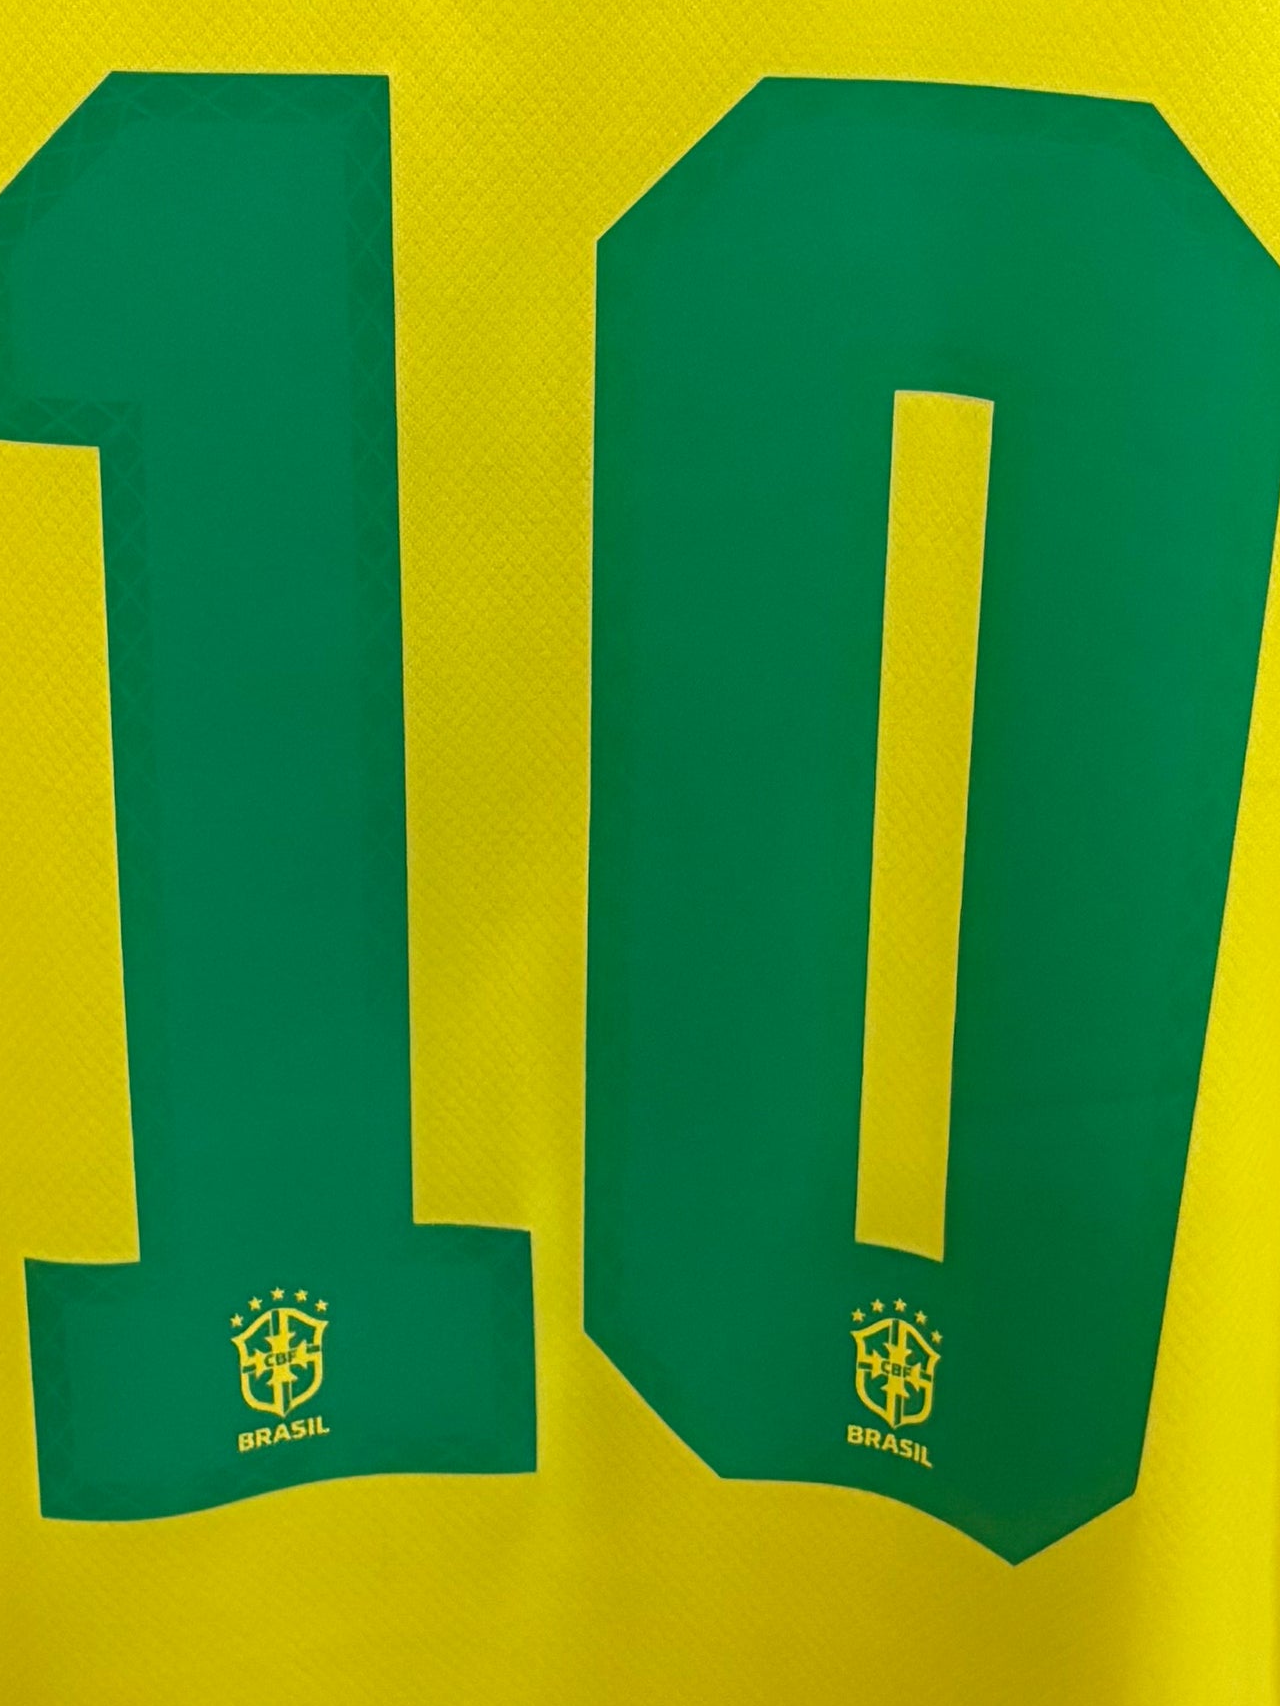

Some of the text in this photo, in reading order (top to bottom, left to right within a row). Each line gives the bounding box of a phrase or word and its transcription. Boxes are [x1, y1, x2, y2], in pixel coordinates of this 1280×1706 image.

[264, 1351, 297, 1367] CBF
[881, 1360, 913, 1379] CBF
[238, 1415, 330, 1453] BRASIL
[847, 1424, 934, 1469] BRASIL
